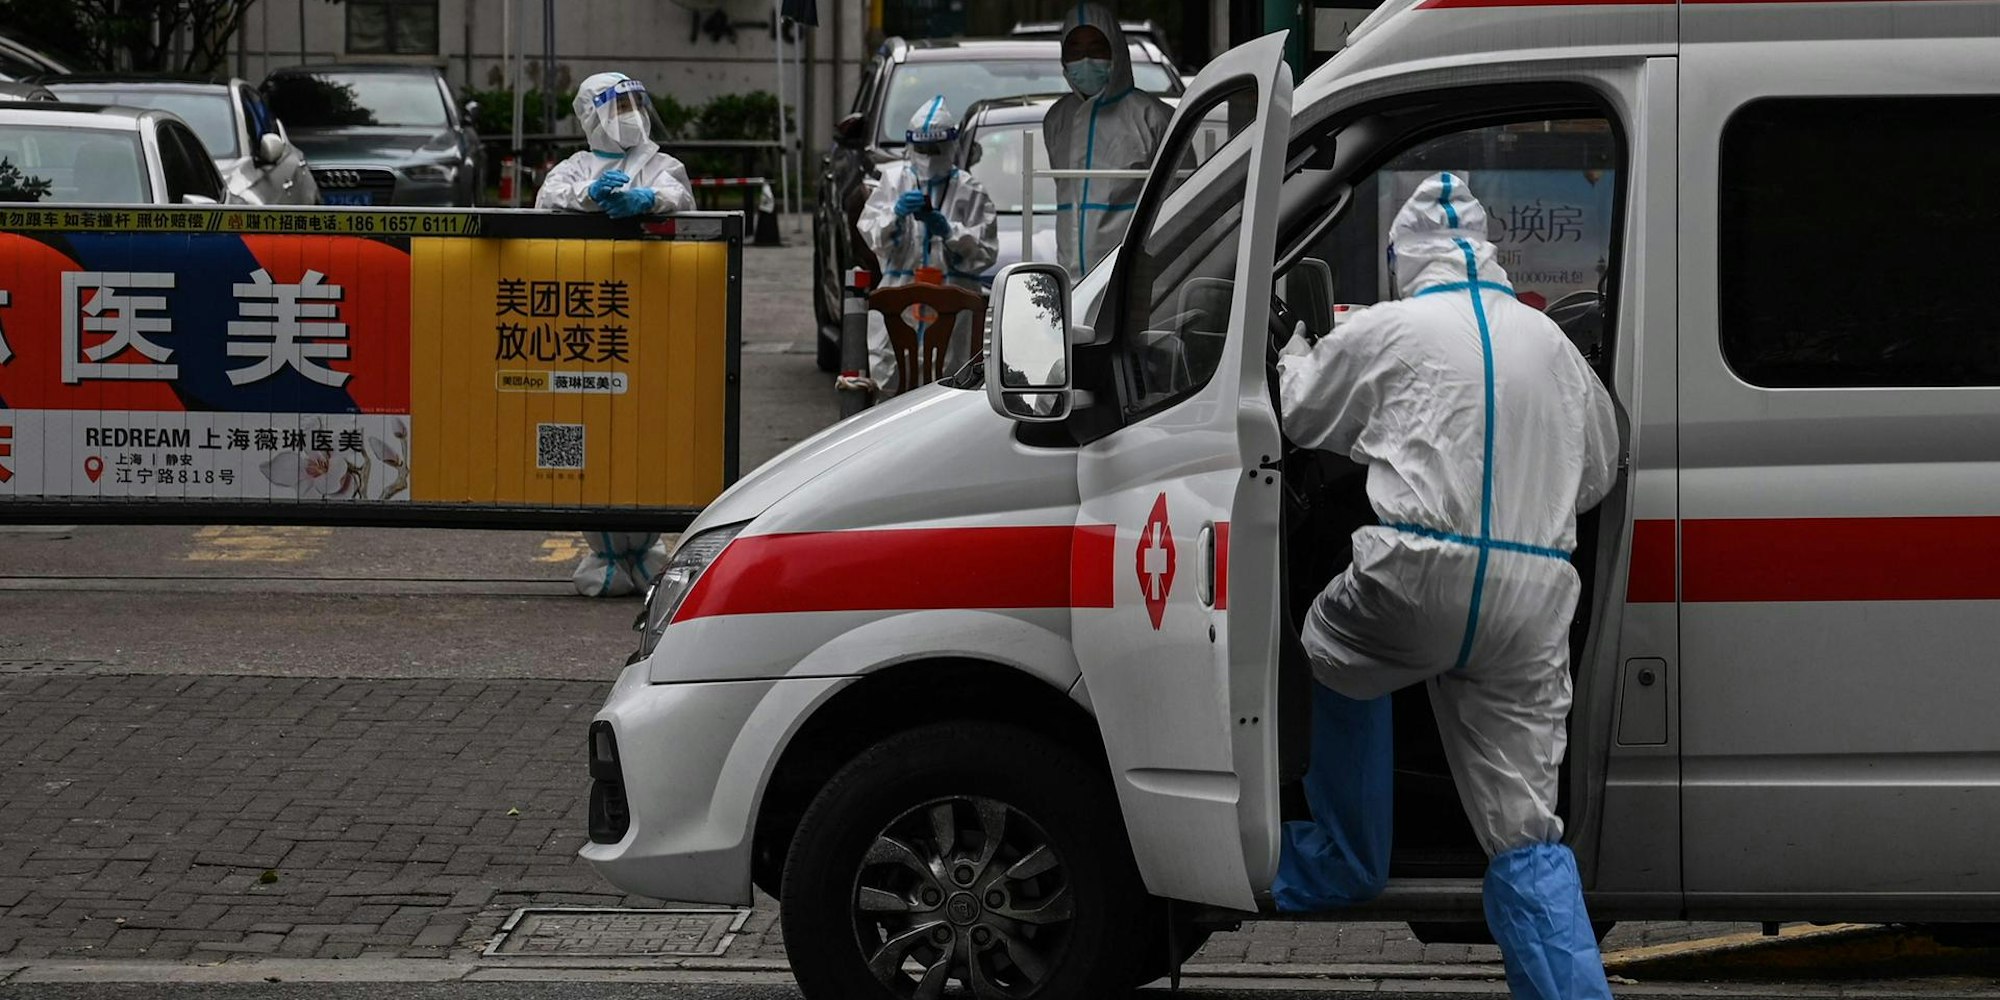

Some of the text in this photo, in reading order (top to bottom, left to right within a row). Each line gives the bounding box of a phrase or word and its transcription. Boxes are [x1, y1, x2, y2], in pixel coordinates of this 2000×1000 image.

[63, 212, 131, 228] 如若撞杆
[136, 213, 204, 228] 照价赔偿
[346, 216, 374, 231] 186
[380, 216, 417, 232] 1657
[422, 217, 457, 232] 6111
[496, 278, 630, 318] 美团医美
[0, 268, 353, 388] 医美
[496, 322, 630, 363] 放心变美
[554, 375, 610, 390] 薇琳医美
[86, 427, 363, 452] REDREAM 上海薇琳医美
[115, 453, 142, 465] 上海
[165, 454, 192, 466] 静安
[116, 467, 235, 485] 江宁路818号
